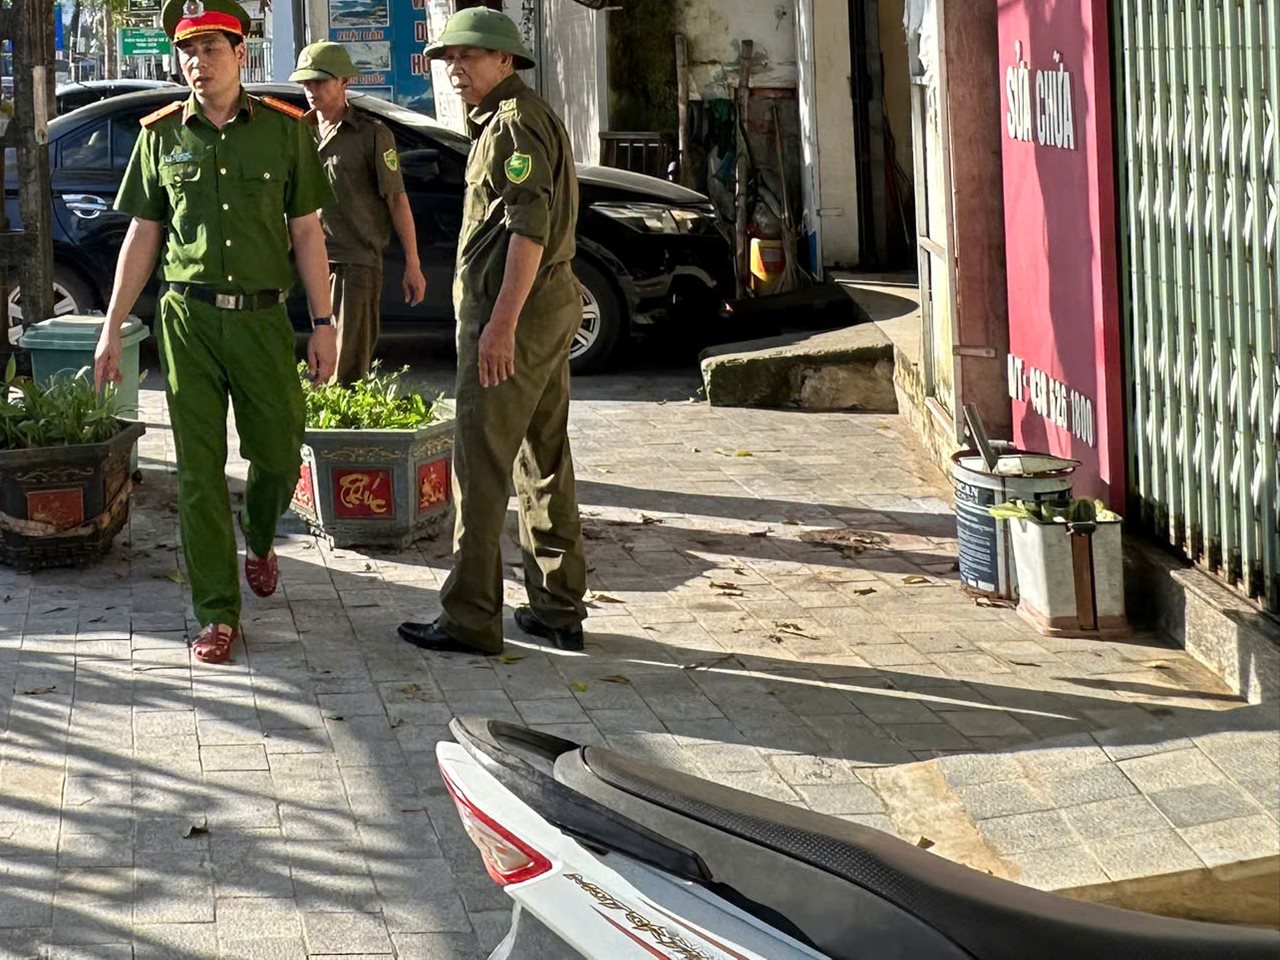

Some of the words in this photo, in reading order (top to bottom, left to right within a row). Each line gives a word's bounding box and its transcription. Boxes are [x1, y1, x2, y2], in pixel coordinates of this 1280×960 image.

[1006, 40, 1033, 142] SỬA
[1035, 49, 1076, 151] CHỮA
[1070, 389, 1093, 447] 1800
